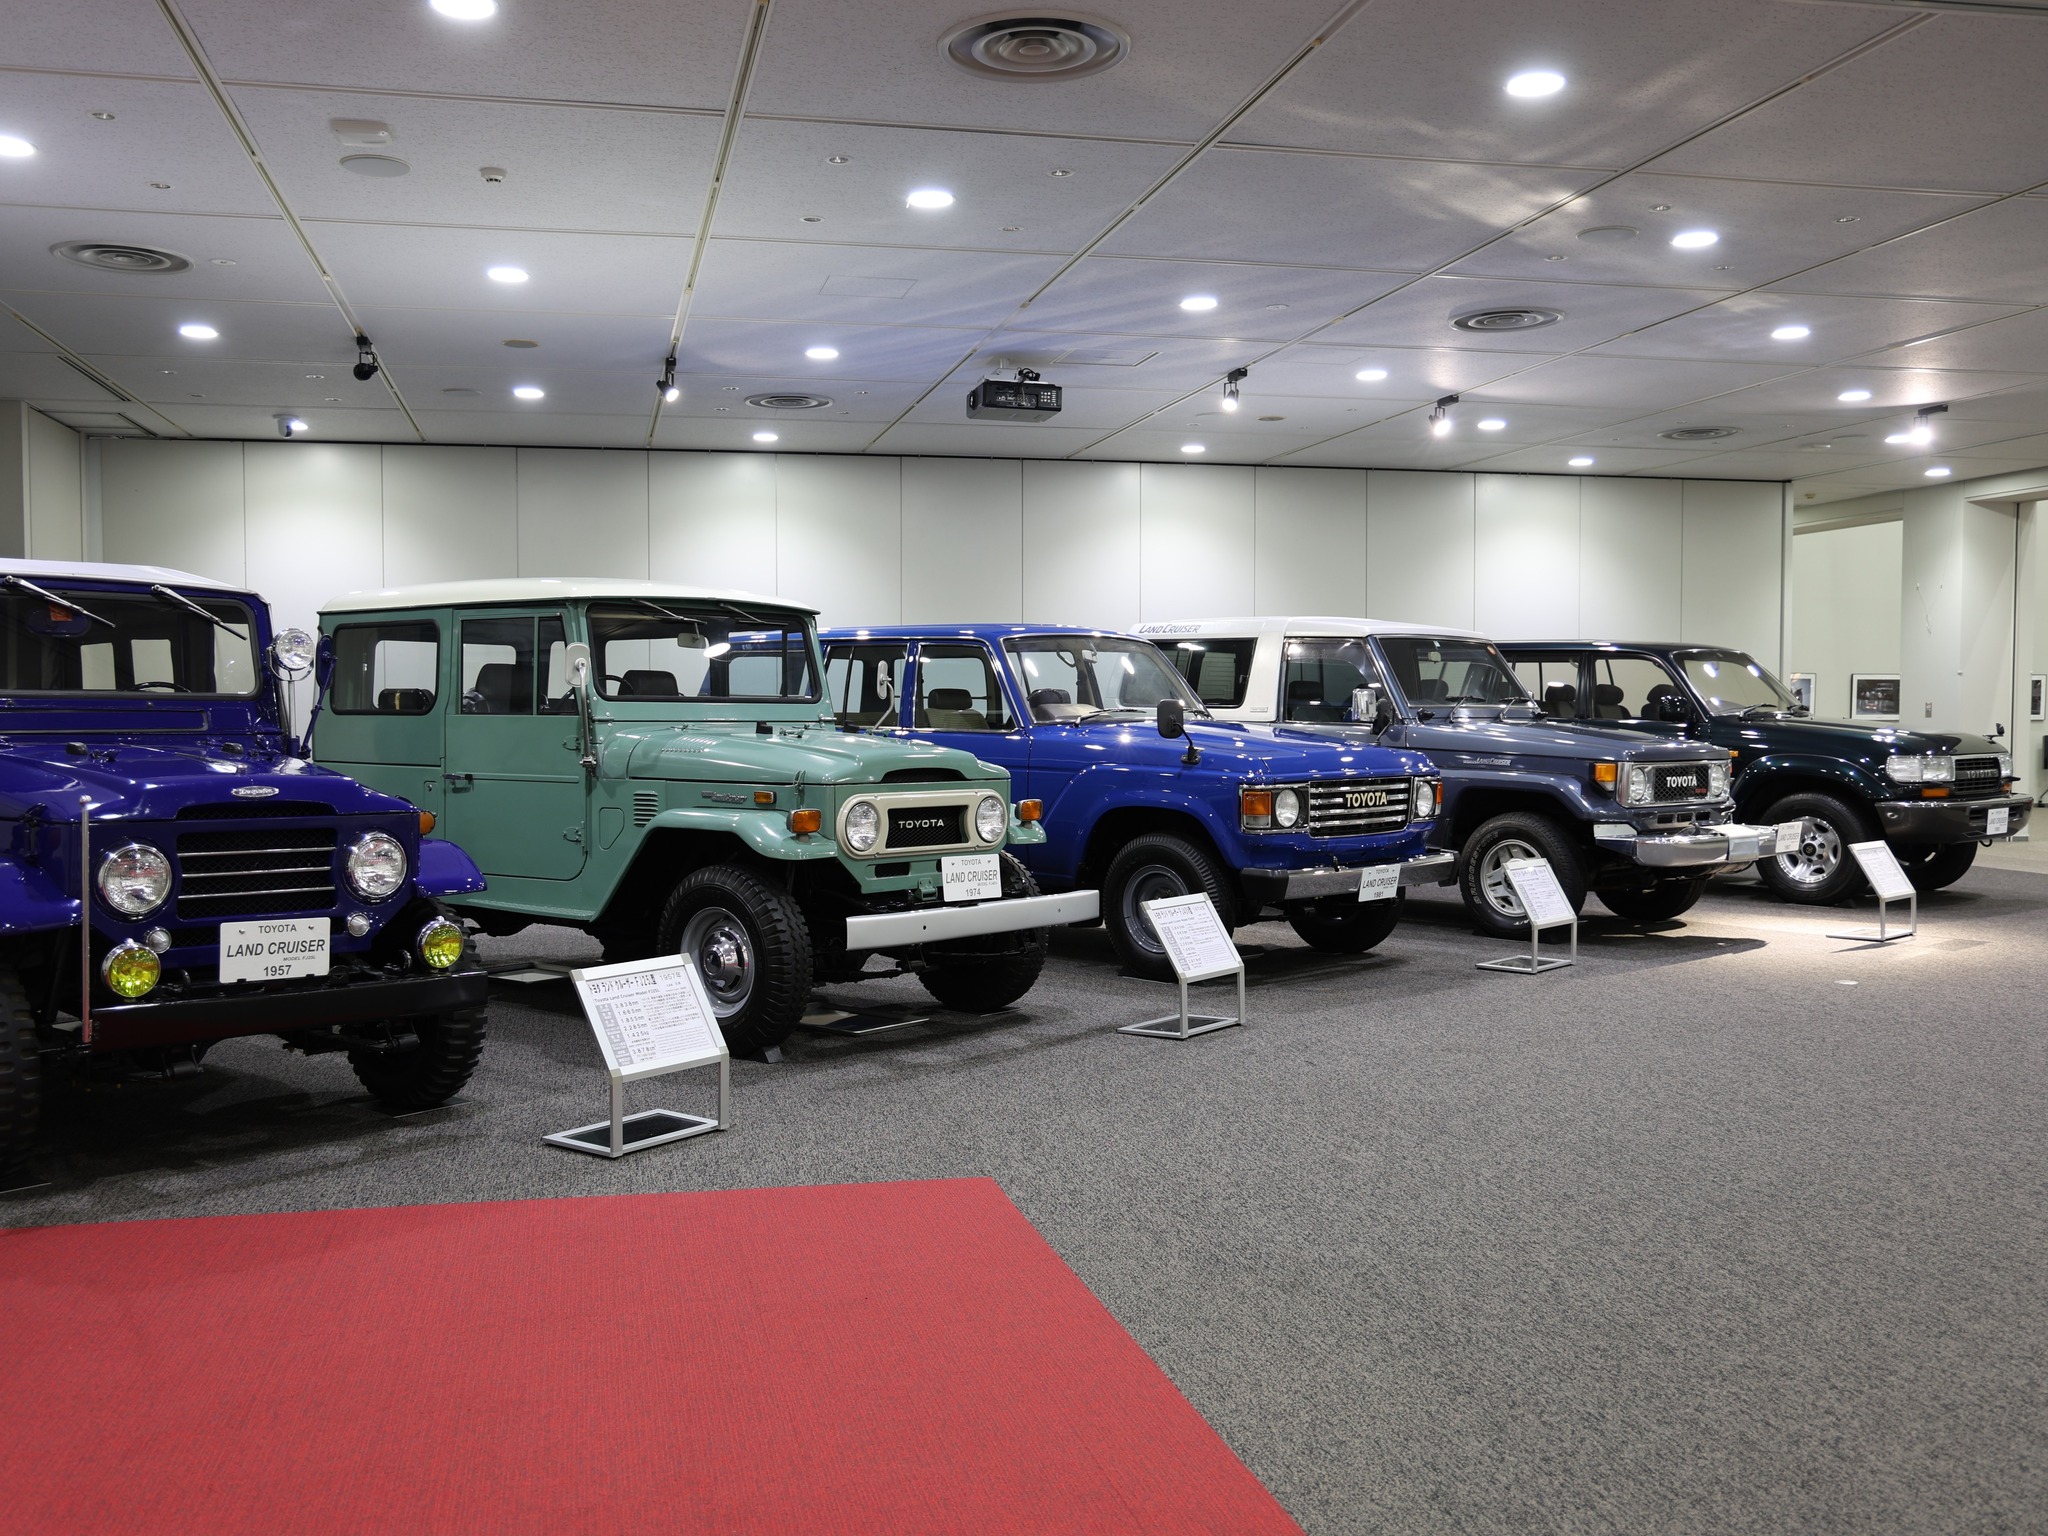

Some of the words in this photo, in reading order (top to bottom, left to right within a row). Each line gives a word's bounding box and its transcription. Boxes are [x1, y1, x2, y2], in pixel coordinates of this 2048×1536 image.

[1966, 770, 1992, 779] TOYOTA
[1666, 775, 1698, 788] TOYOTA
[1345, 792, 1388, 807] TOYOTA
[898, 819, 944, 829] TOYOTA
[945, 872, 966, 884] LAND
[967, 869, 998, 882] CRUISER
[1362, 879, 1377, 889] LAND
[1377, 876, 1397, 887] CRUISER
[965, 888, 981, 897] 1974
[258, 924, 297, 934] TOYOTA
[226, 943, 264, 958] LAND
[267, 939, 326, 955] CRUISER
[263, 964, 292, 977] 1957
